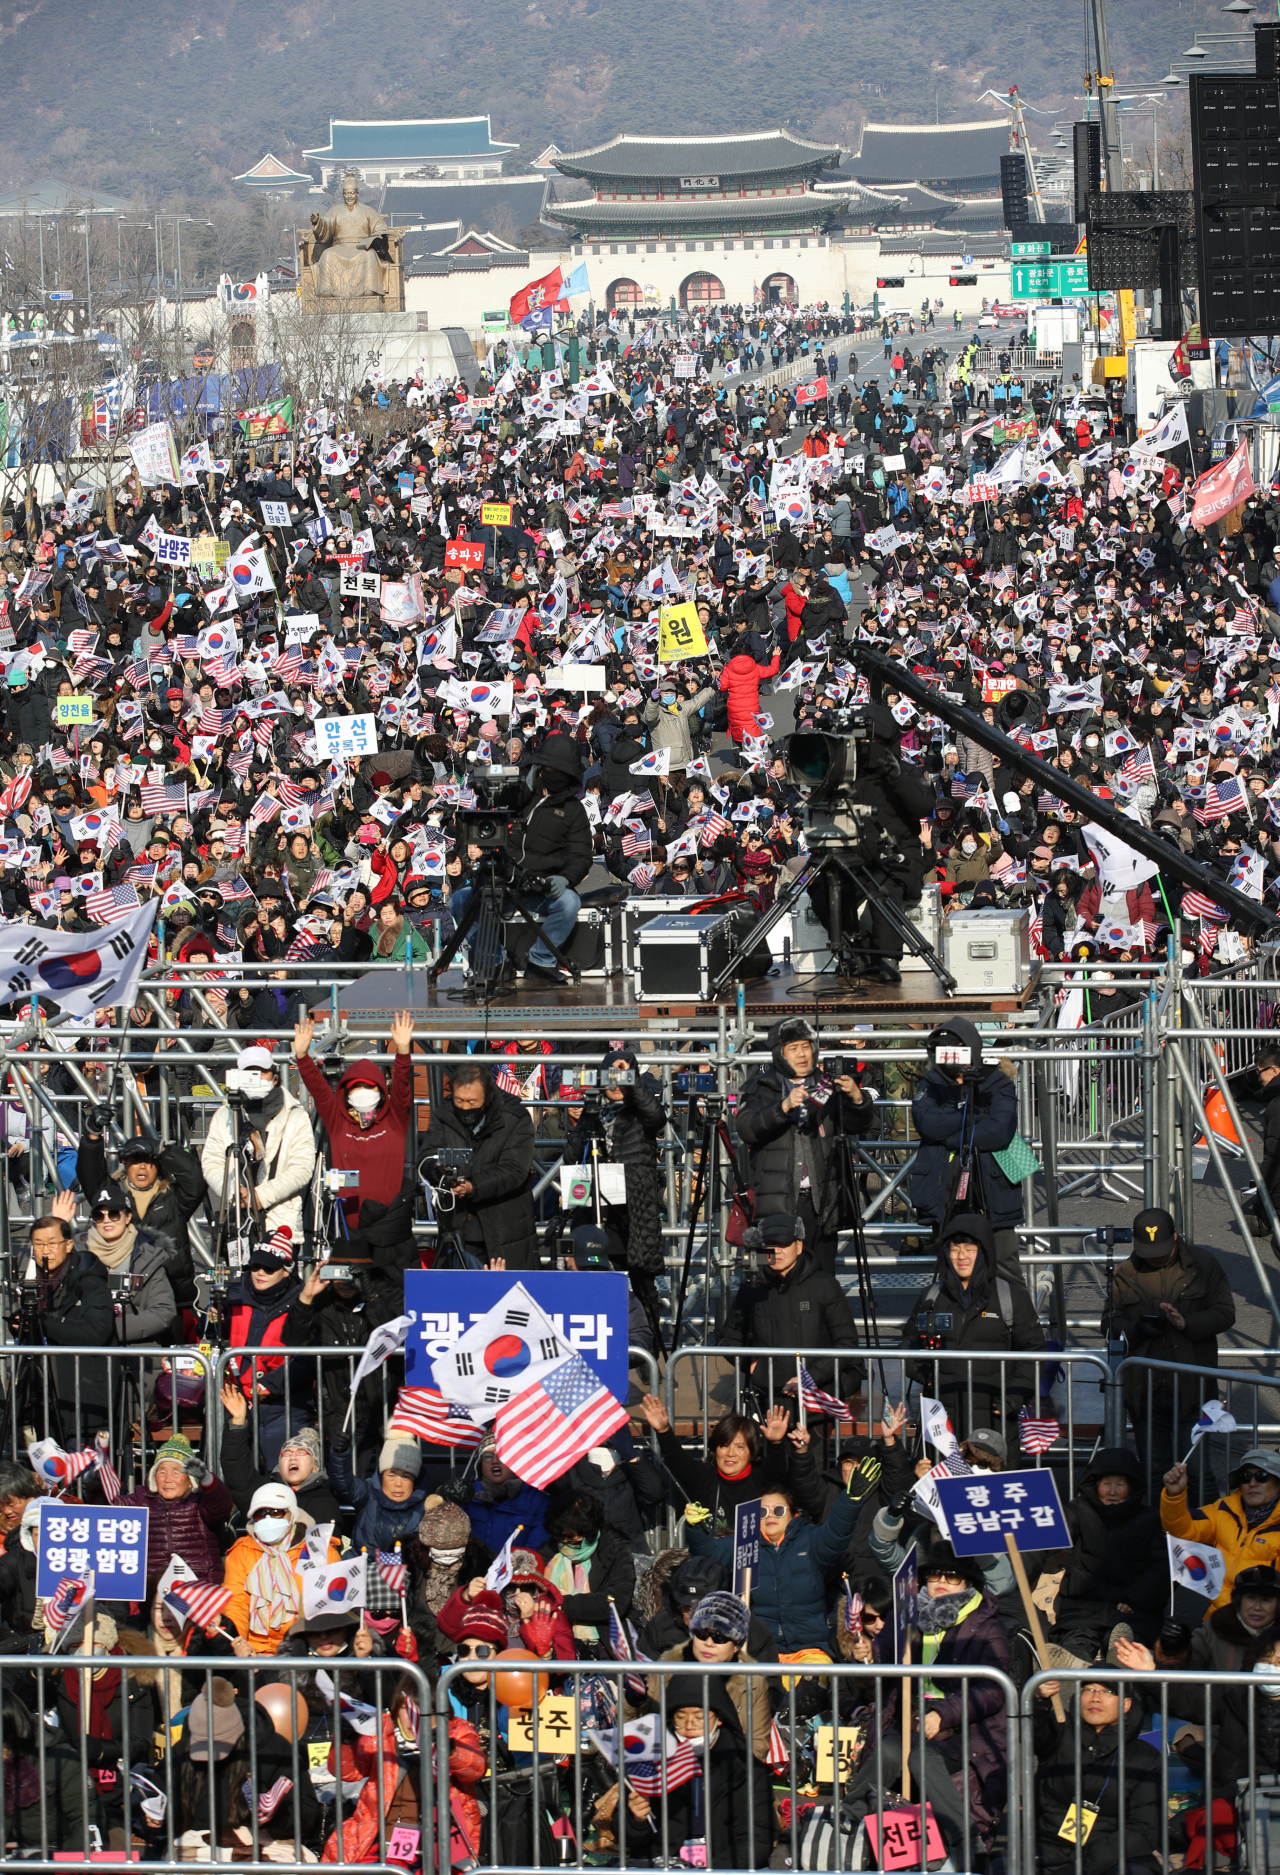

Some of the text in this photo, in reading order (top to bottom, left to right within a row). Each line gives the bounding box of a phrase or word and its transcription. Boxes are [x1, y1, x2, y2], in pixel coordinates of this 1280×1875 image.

[1017, 244, 1045, 253] 광화문
[1028, 269, 1054, 278] 광화문
[1142, 458, 1164, 468] 용산구
[268, 515, 287, 523] 단원구
[159, 538, 189, 561] 남양주
[344, 576, 376, 592] 전북
[988, 680, 1016, 690] 문재인
[60, 704, 90, 717] 양천을
[328, 738, 367, 754] 상록구
[984, 971, 993, 986] 5
[954, 1506, 1055, 1535] 동남구 갑
[47, 1517, 142, 1545] 장성 담양
[47, 1547, 139, 1574] 영광 함평
[736, 1541, 753, 1570] 동남구
[517, 1707, 572, 1741] 광주
[393, 1840, 414, 1857] 19
